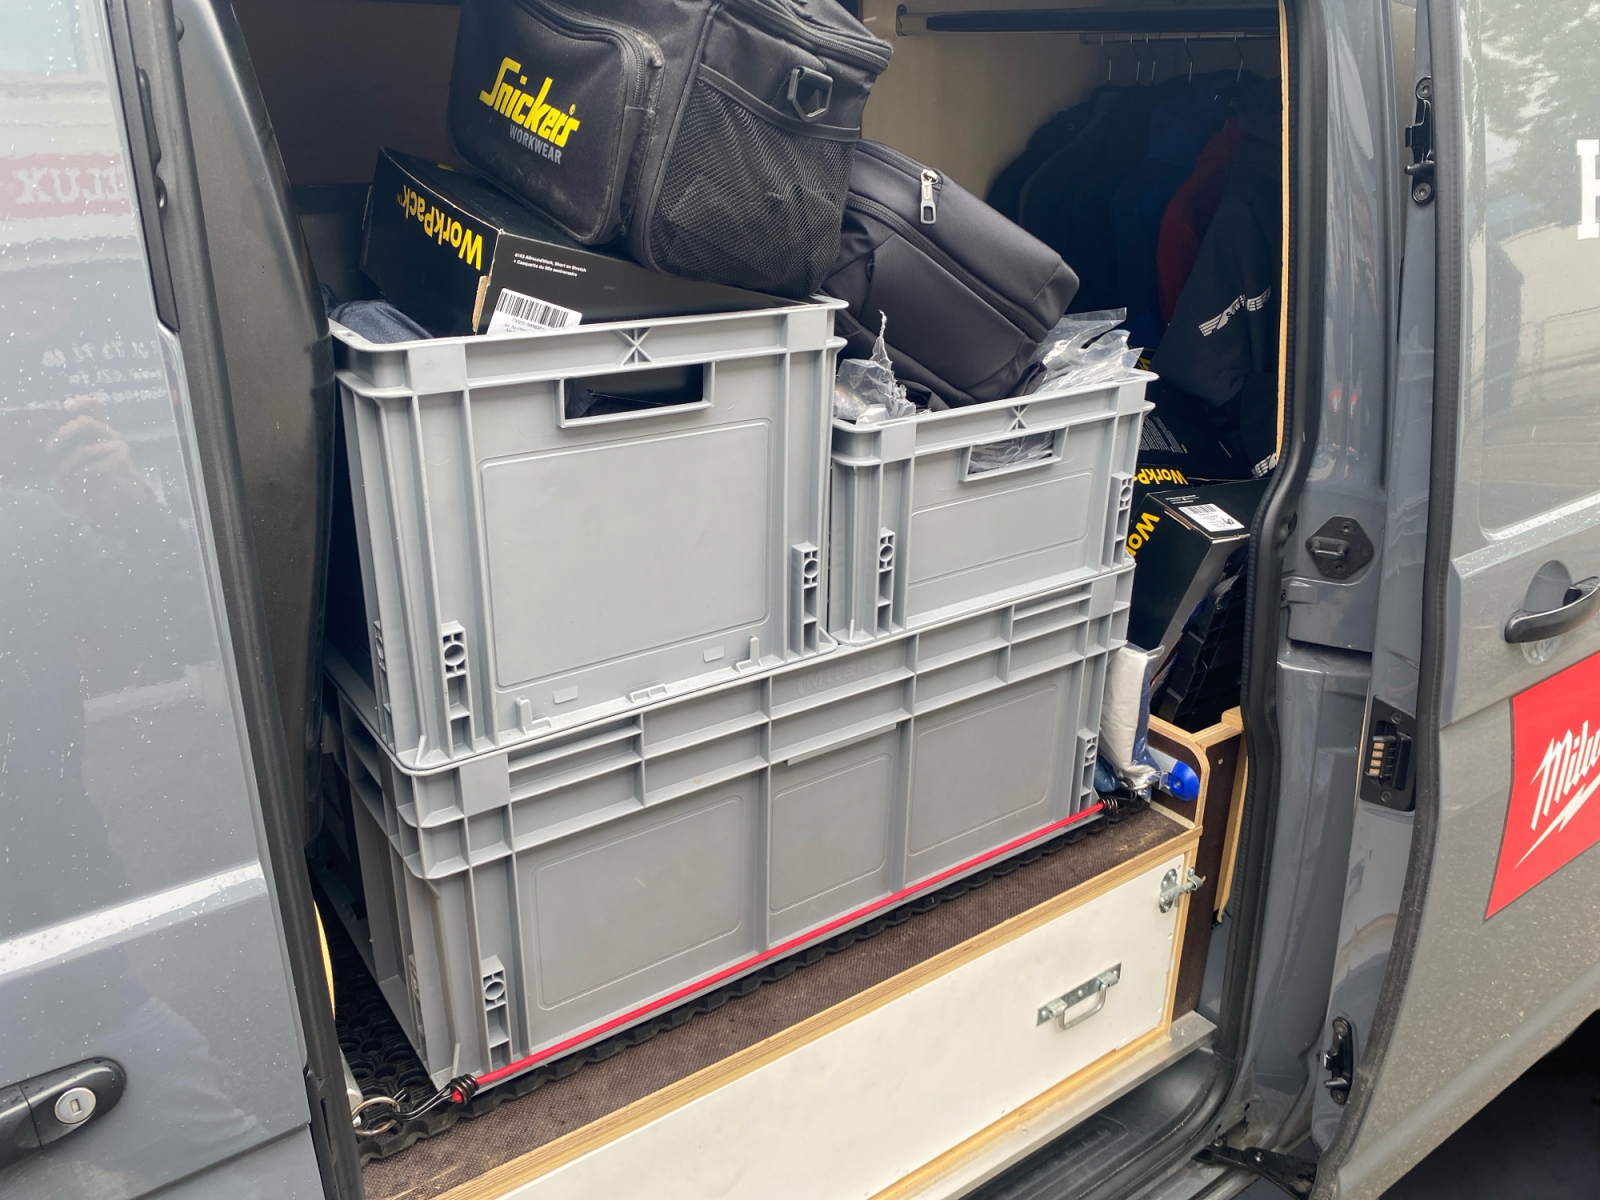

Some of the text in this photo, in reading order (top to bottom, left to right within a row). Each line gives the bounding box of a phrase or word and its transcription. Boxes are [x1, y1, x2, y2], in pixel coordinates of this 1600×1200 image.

[479, 57, 580, 147] Snickers
[509, 124, 562, 165] WORKWEAR
[400, 184, 483, 271] WorkPack
